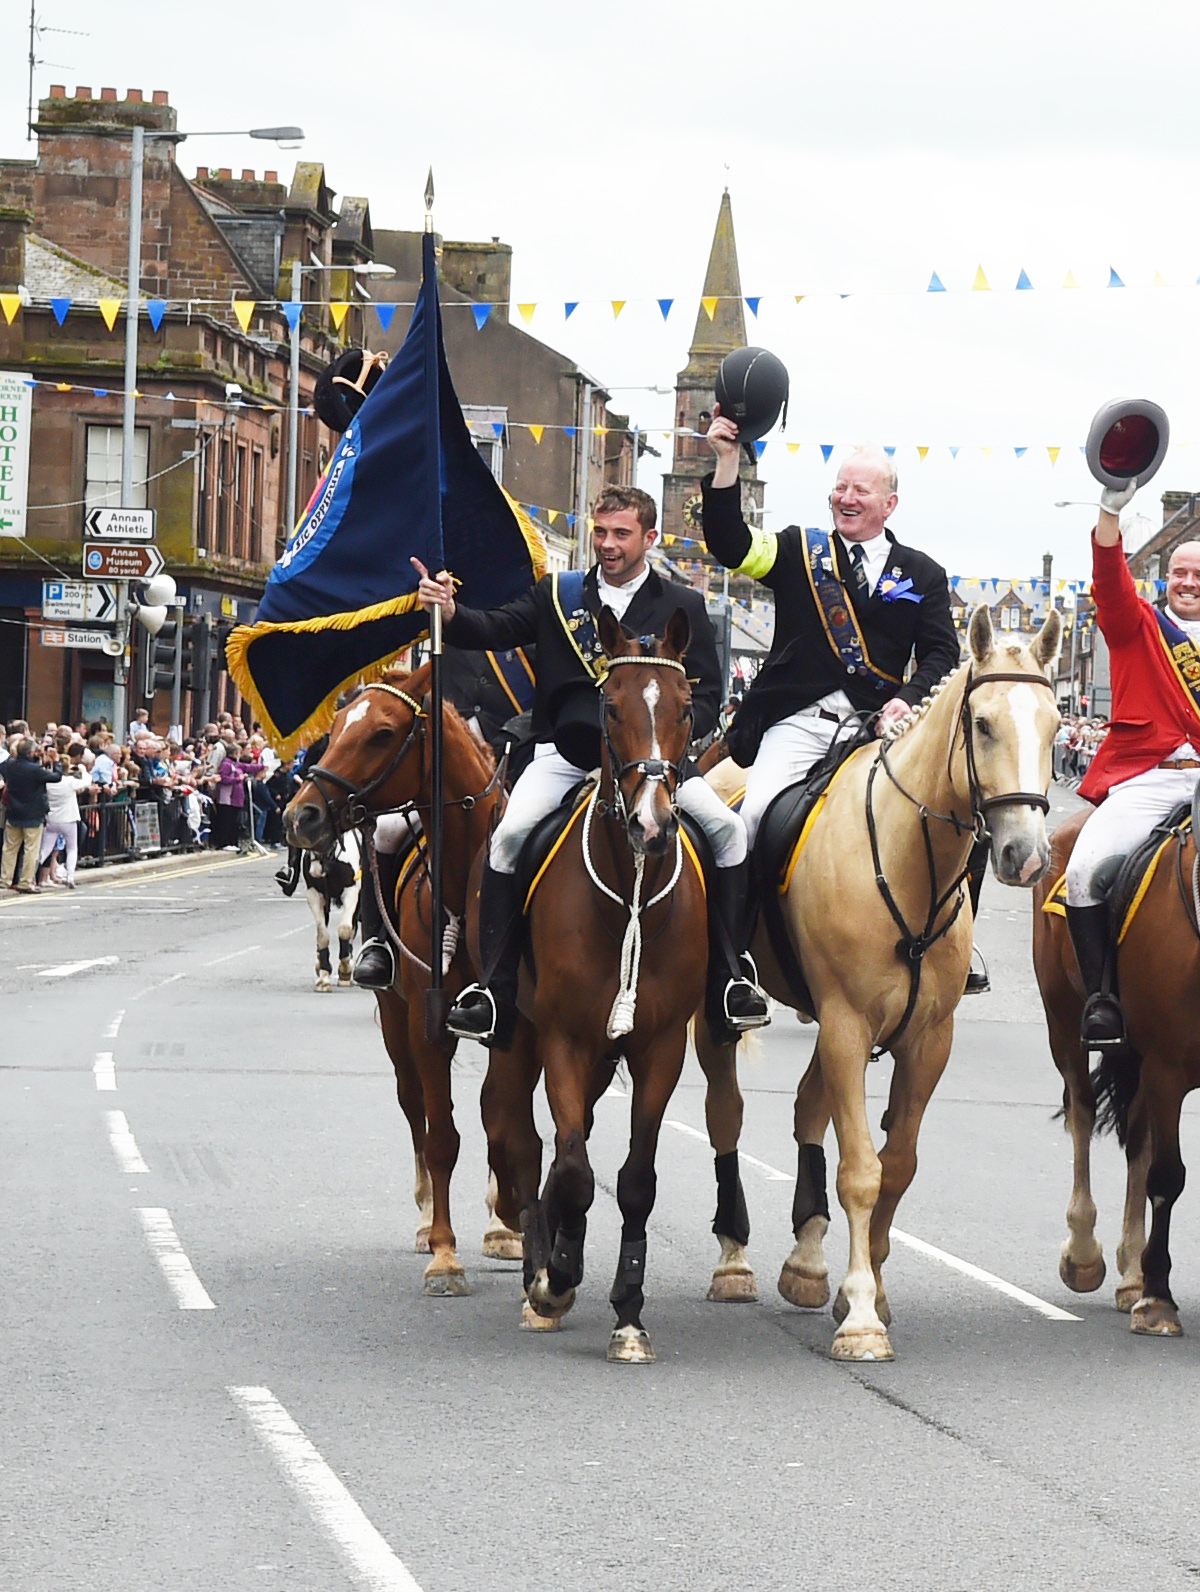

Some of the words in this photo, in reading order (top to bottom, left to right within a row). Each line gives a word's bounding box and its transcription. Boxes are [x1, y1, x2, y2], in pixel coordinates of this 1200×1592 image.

[0, 384, 28, 393] ORNER
[0, 405, 18, 502] HOTEL
[111, 513, 144, 522] Annan
[106, 524, 148, 534] Athletic
[111, 548, 138, 557] Annan
[106, 557, 143, 566] Museum
[108, 566, 119, 574] 80
[120, 567, 140, 575] yards
[45, 601, 81, 609] Swimming
[67, 633, 101, 643] Station
